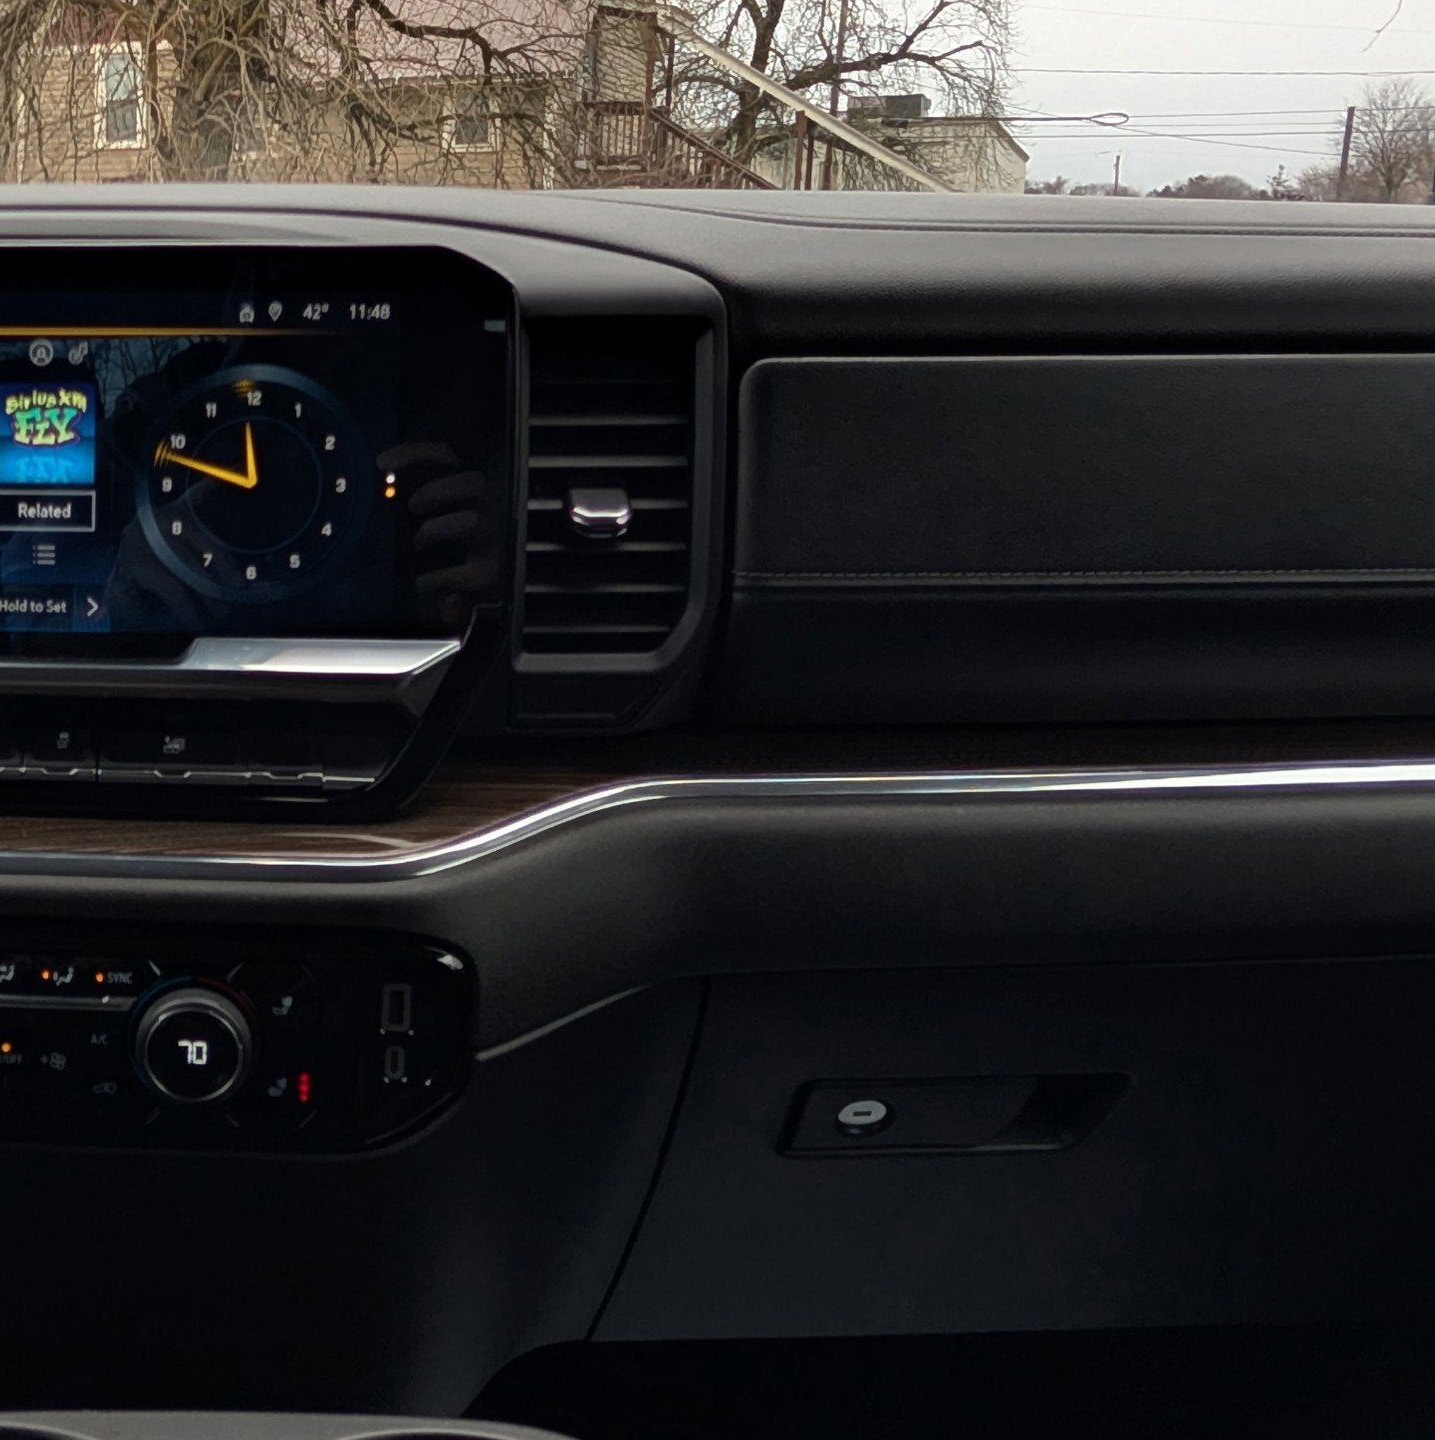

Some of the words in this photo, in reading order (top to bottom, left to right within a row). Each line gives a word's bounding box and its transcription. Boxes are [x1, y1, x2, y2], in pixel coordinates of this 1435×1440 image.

[349, 302, 391, 321] 11:48
[245, 390, 263, 407] 12
[294, 402, 302, 418] 1
[324, 434, 337, 451] 2
[161, 476, 173, 494] 9
[334, 477, 347, 494] 3
[17, 503, 72, 520] Related
[320, 522, 333, 538] 4
[202, 552, 214, 569] 7
[288, 554, 301, 570] 5
[245, 563, 258, 581] 6
[29, 601, 44, 614] to
[46, 600, 67, 615] Set
[106, 971, 134, 985] SYNC
[177, 1039, 208, 1066] 70
